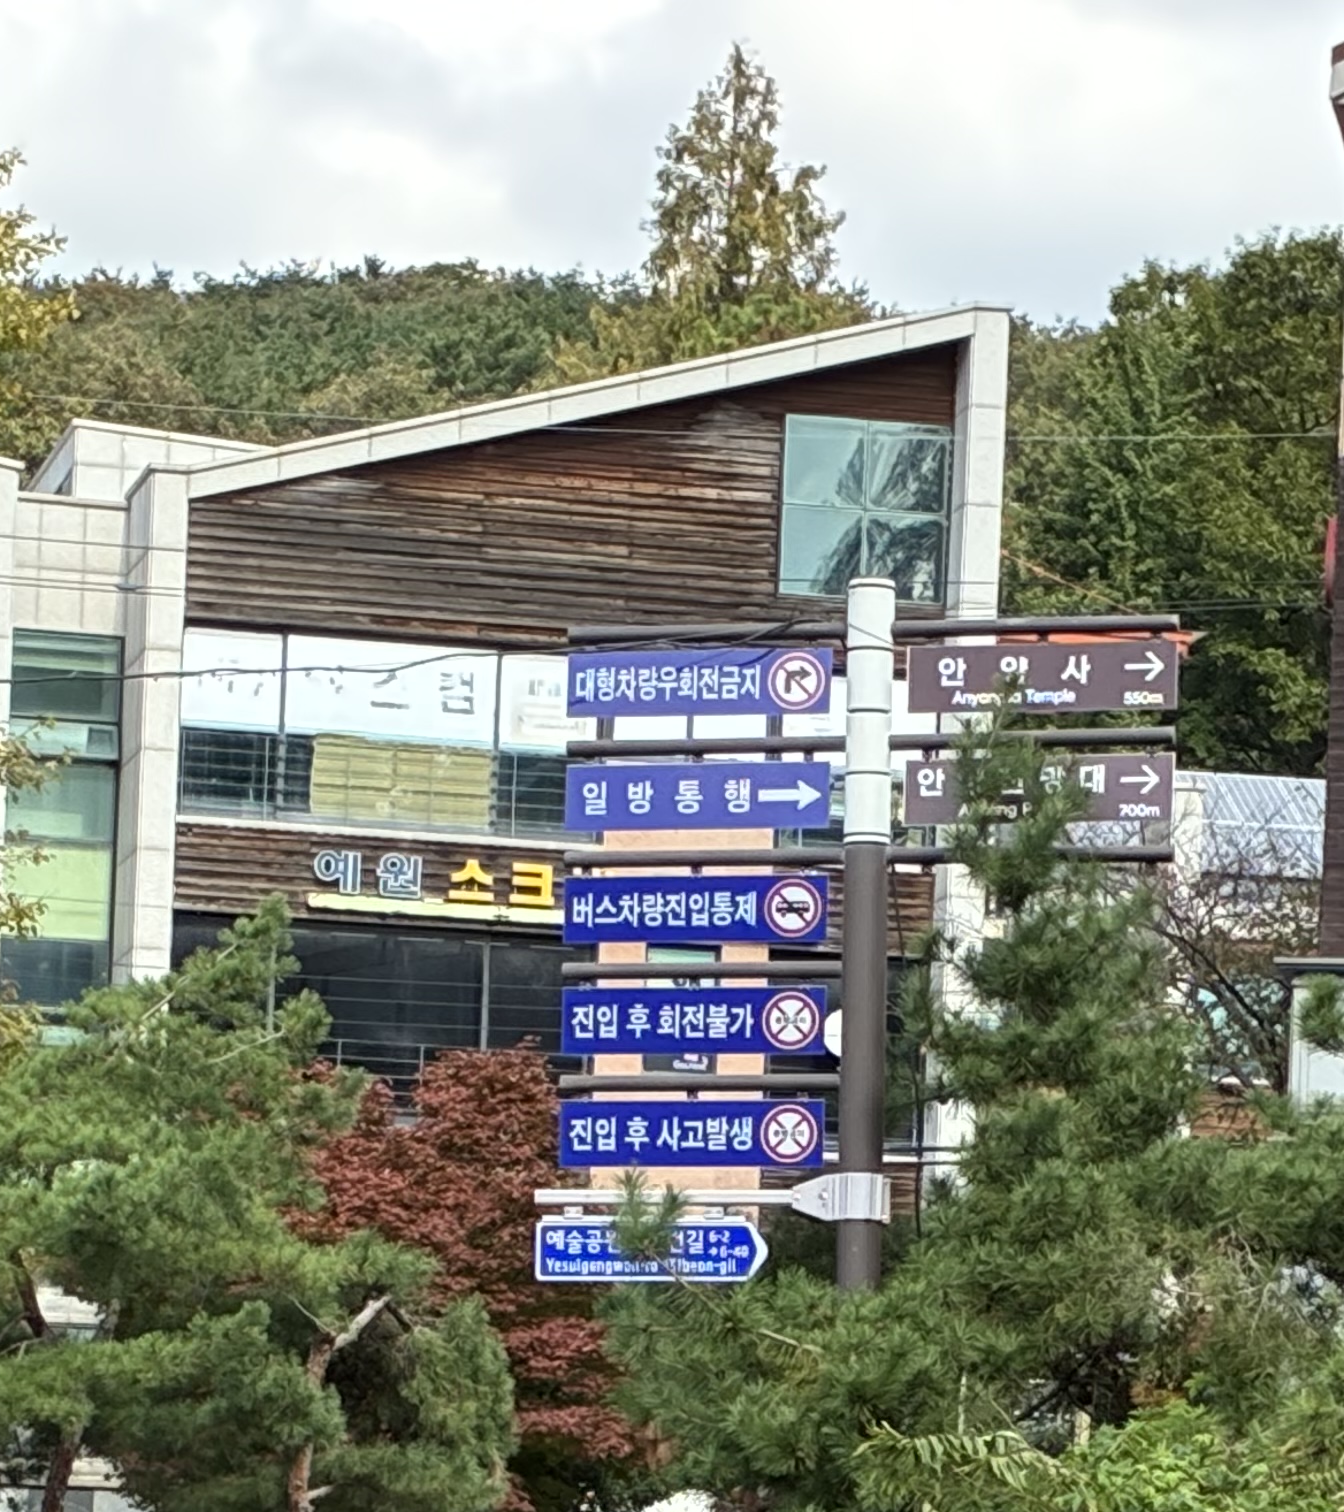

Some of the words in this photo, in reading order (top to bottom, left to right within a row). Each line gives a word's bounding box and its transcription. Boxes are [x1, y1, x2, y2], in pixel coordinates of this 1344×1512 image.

[575, 664, 761, 702] 대형차량우회전금지
[1025, 687, 1077, 705] Temple
[1122, 690, 1164, 706] 550m
[1118, 803, 1161, 818] 700m
[572, 890, 758, 928] 버스차량진입통제
[571, 1003, 619, 1039] 진입
[626, 1003, 651, 1039] 후
[657, 1003, 755, 1039] 회전불가
[569, 1116, 617, 1152] 진입
[624, 1116, 650, 1152] 후
[656, 1116, 754, 1152] 사고발생
